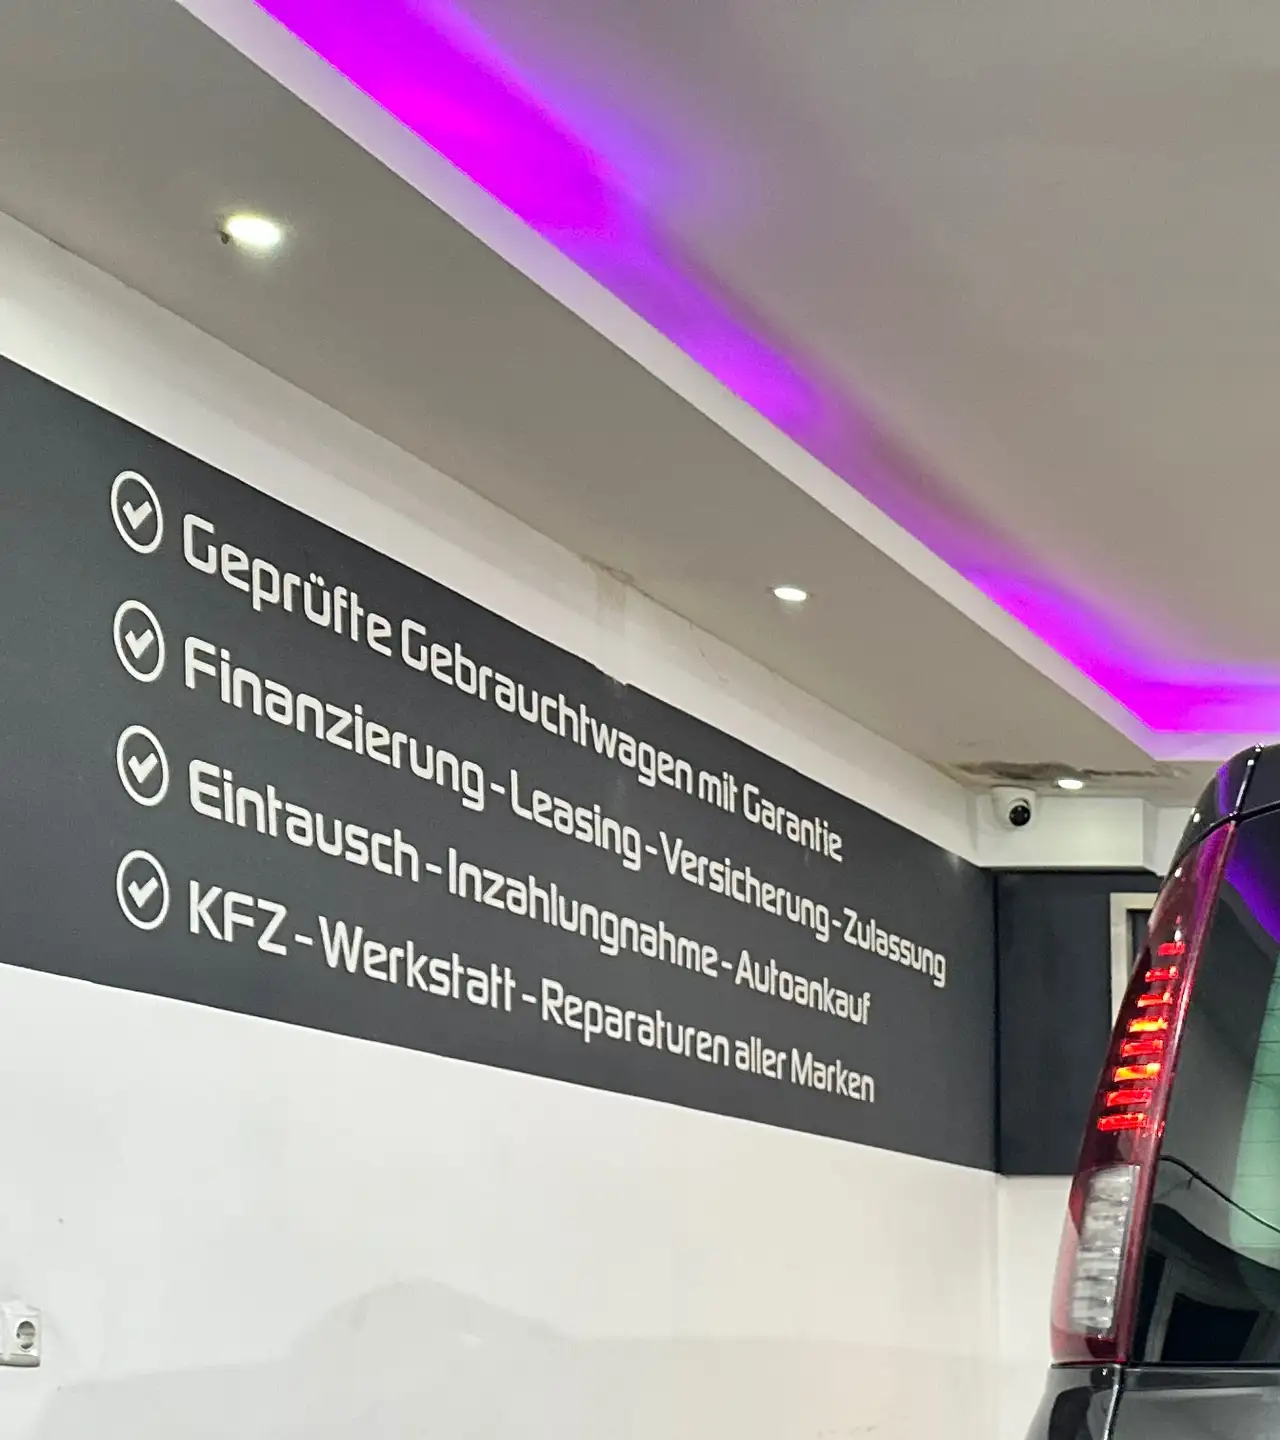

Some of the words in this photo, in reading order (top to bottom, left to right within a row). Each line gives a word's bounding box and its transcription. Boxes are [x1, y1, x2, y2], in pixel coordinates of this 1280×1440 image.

[184, 514, 391, 656] Geprüfte
[402, 619, 693, 794] Gebrauchtwagen
[698, 771, 738, 813] mit
[743, 784, 843, 863] Garantie
[735, 1036, 786, 1080] aller
[791, 1047, 875, 1103] Marken
